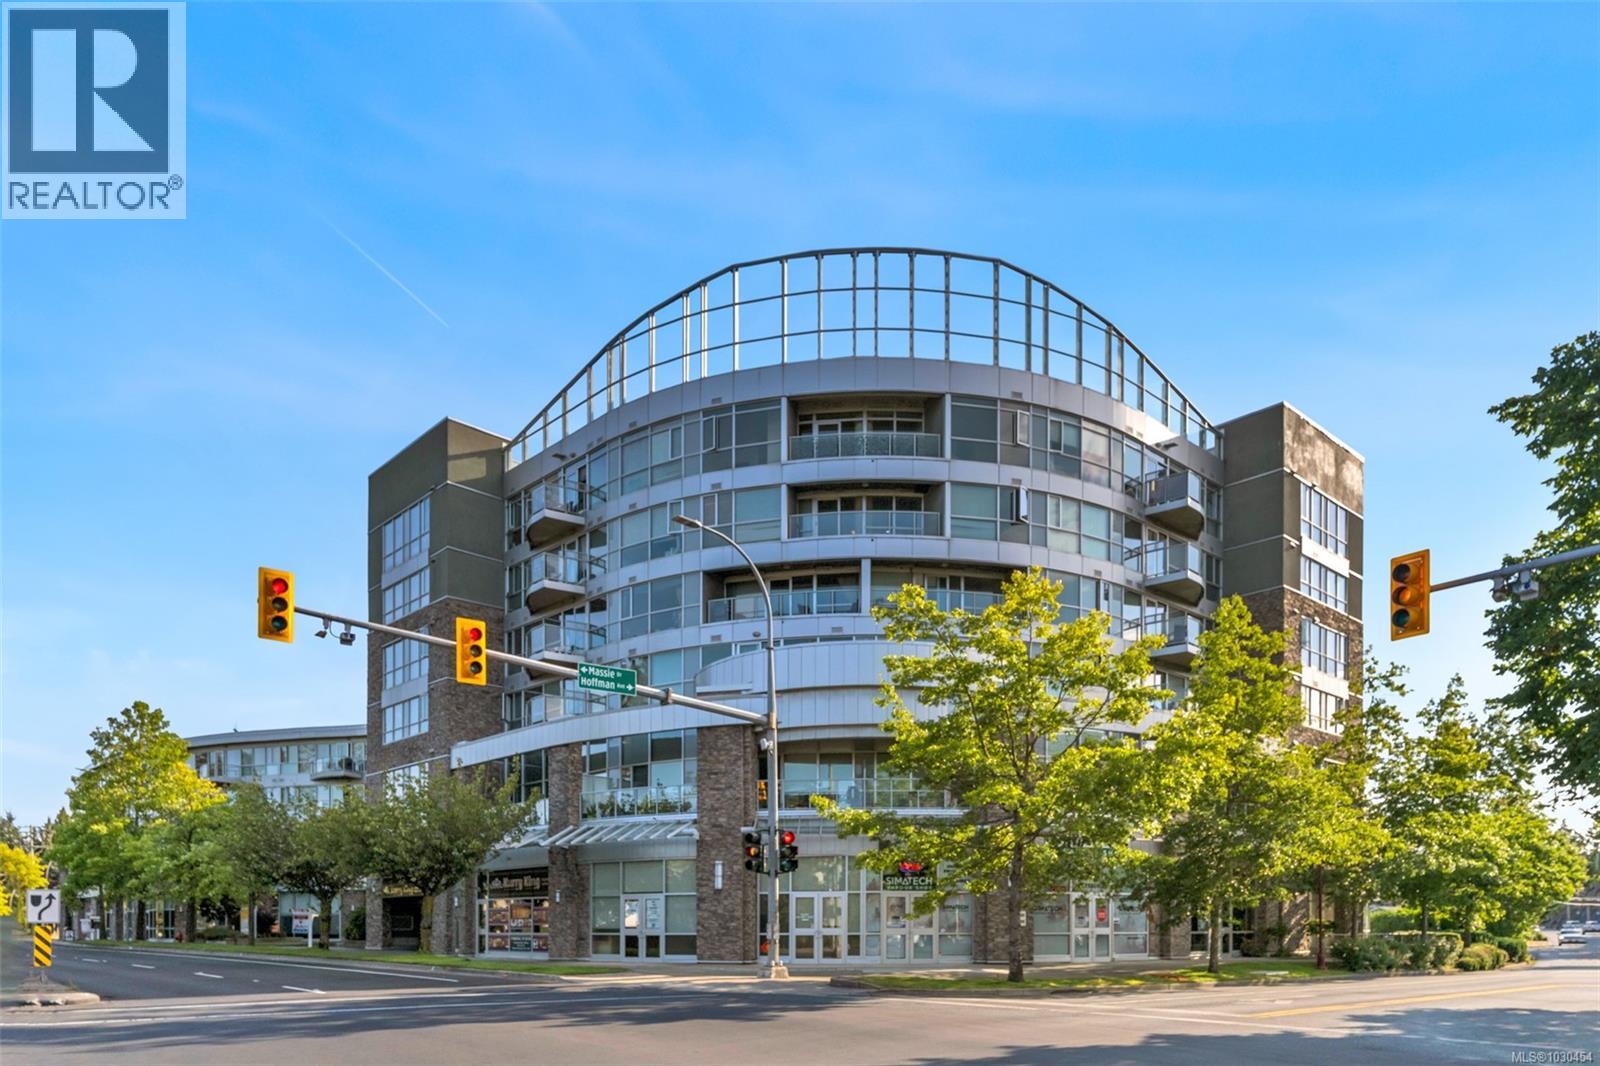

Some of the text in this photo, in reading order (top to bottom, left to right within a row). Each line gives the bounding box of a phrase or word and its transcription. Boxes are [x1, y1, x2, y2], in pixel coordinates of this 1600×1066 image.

[588, 666, 615, 679] Massie
[580, 677, 615, 690] Hoffman
[886, 876, 933, 886] SIMATECH
